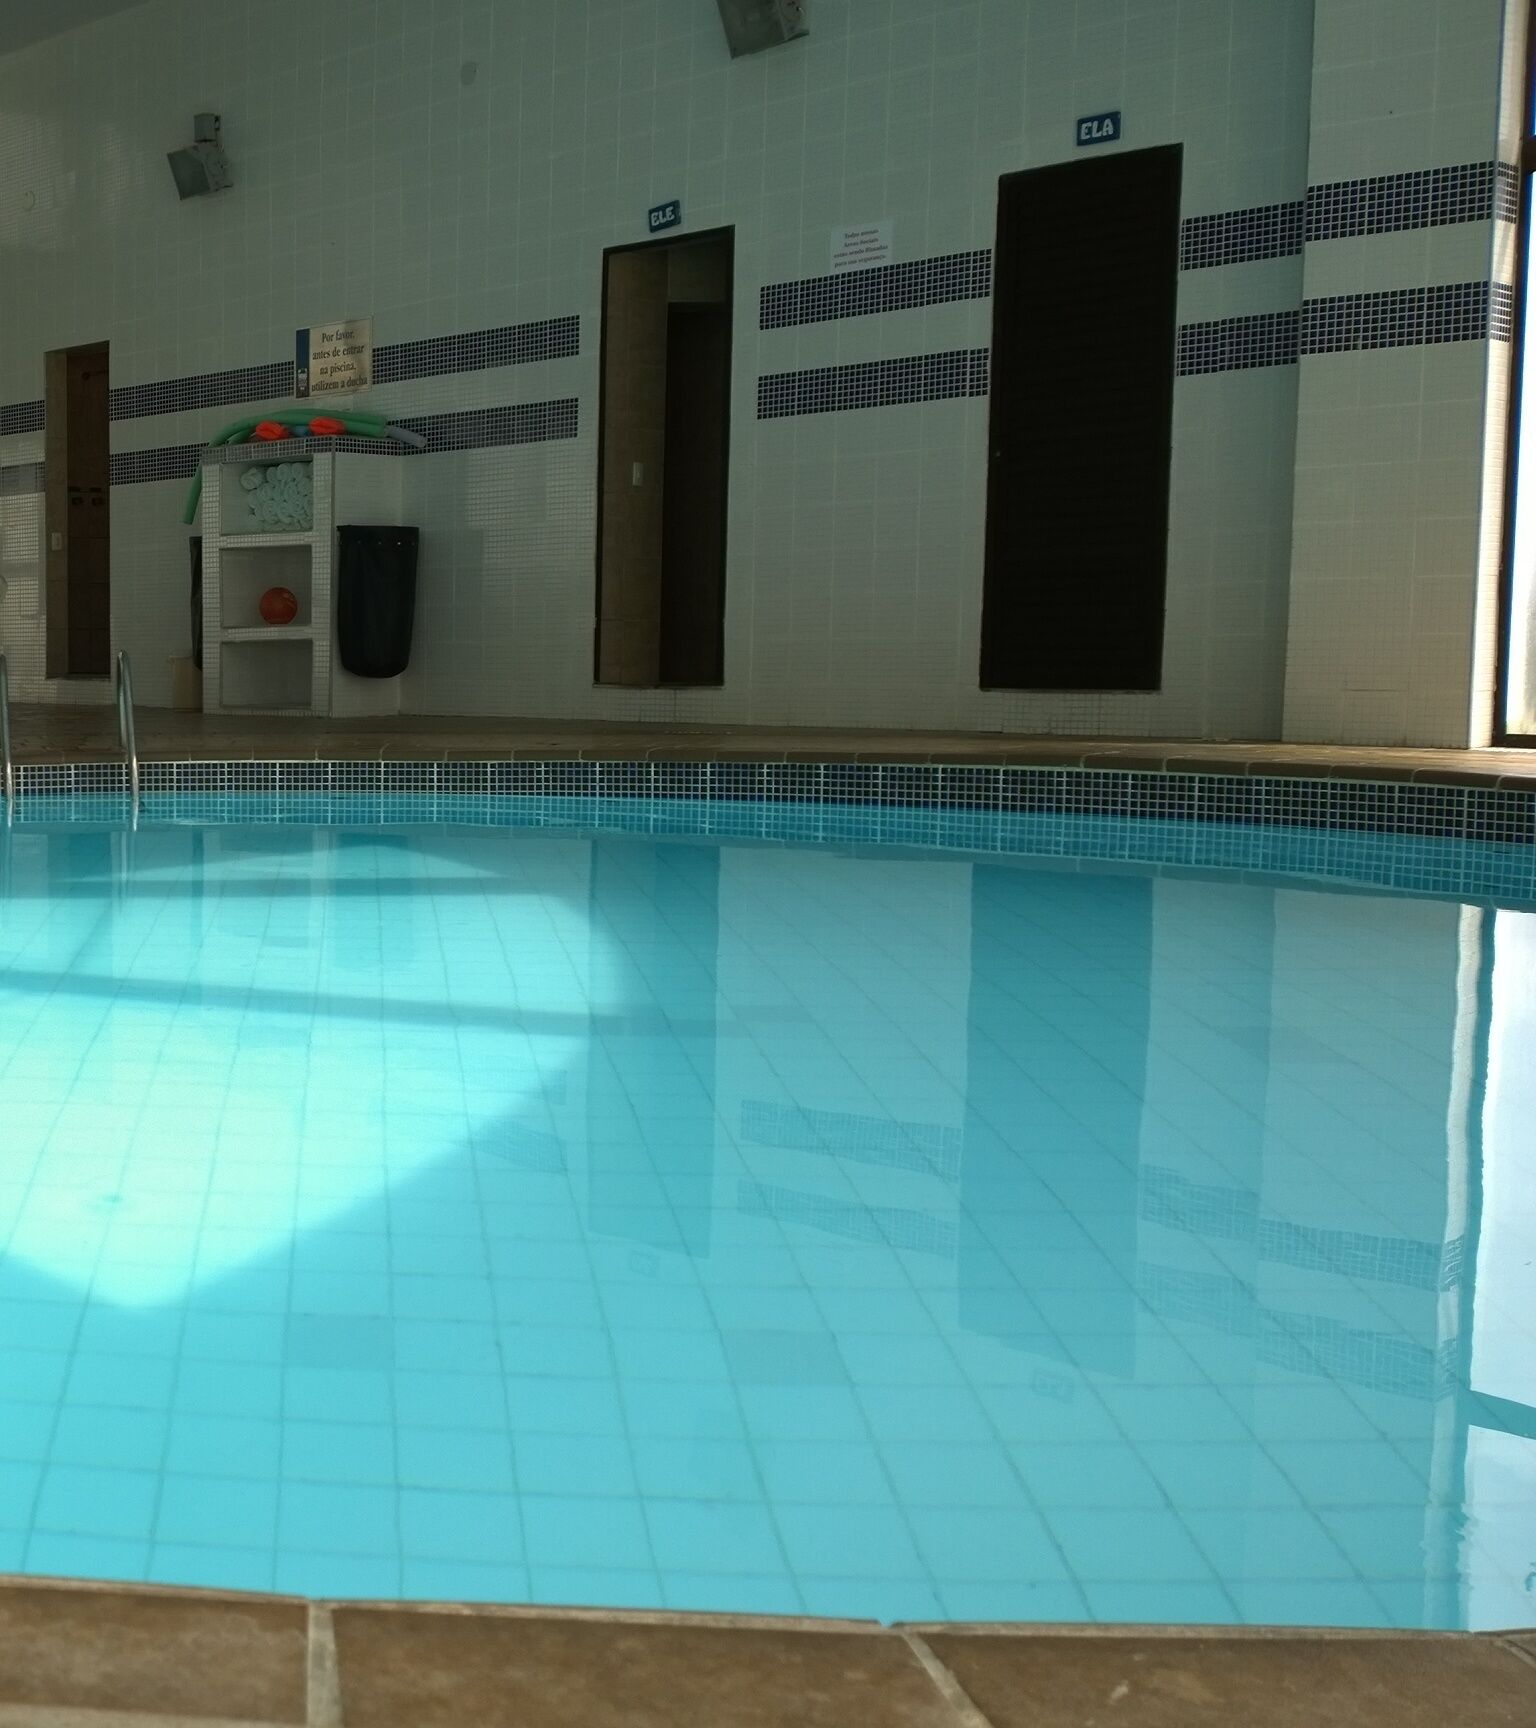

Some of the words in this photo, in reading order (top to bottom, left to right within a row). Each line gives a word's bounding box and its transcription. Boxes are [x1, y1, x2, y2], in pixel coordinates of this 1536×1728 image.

[1080, 118, 1114, 140] ELA
[651, 206, 675, 226] ELE
[321, 332, 334, 343] Por
[312, 350, 331, 360] antes
[332, 346, 341, 357] de
[342, 345, 365, 356] entrar
[320, 366, 329, 375] na
[311, 379, 339, 392] utilizem
[346, 375, 368, 388] ducha
